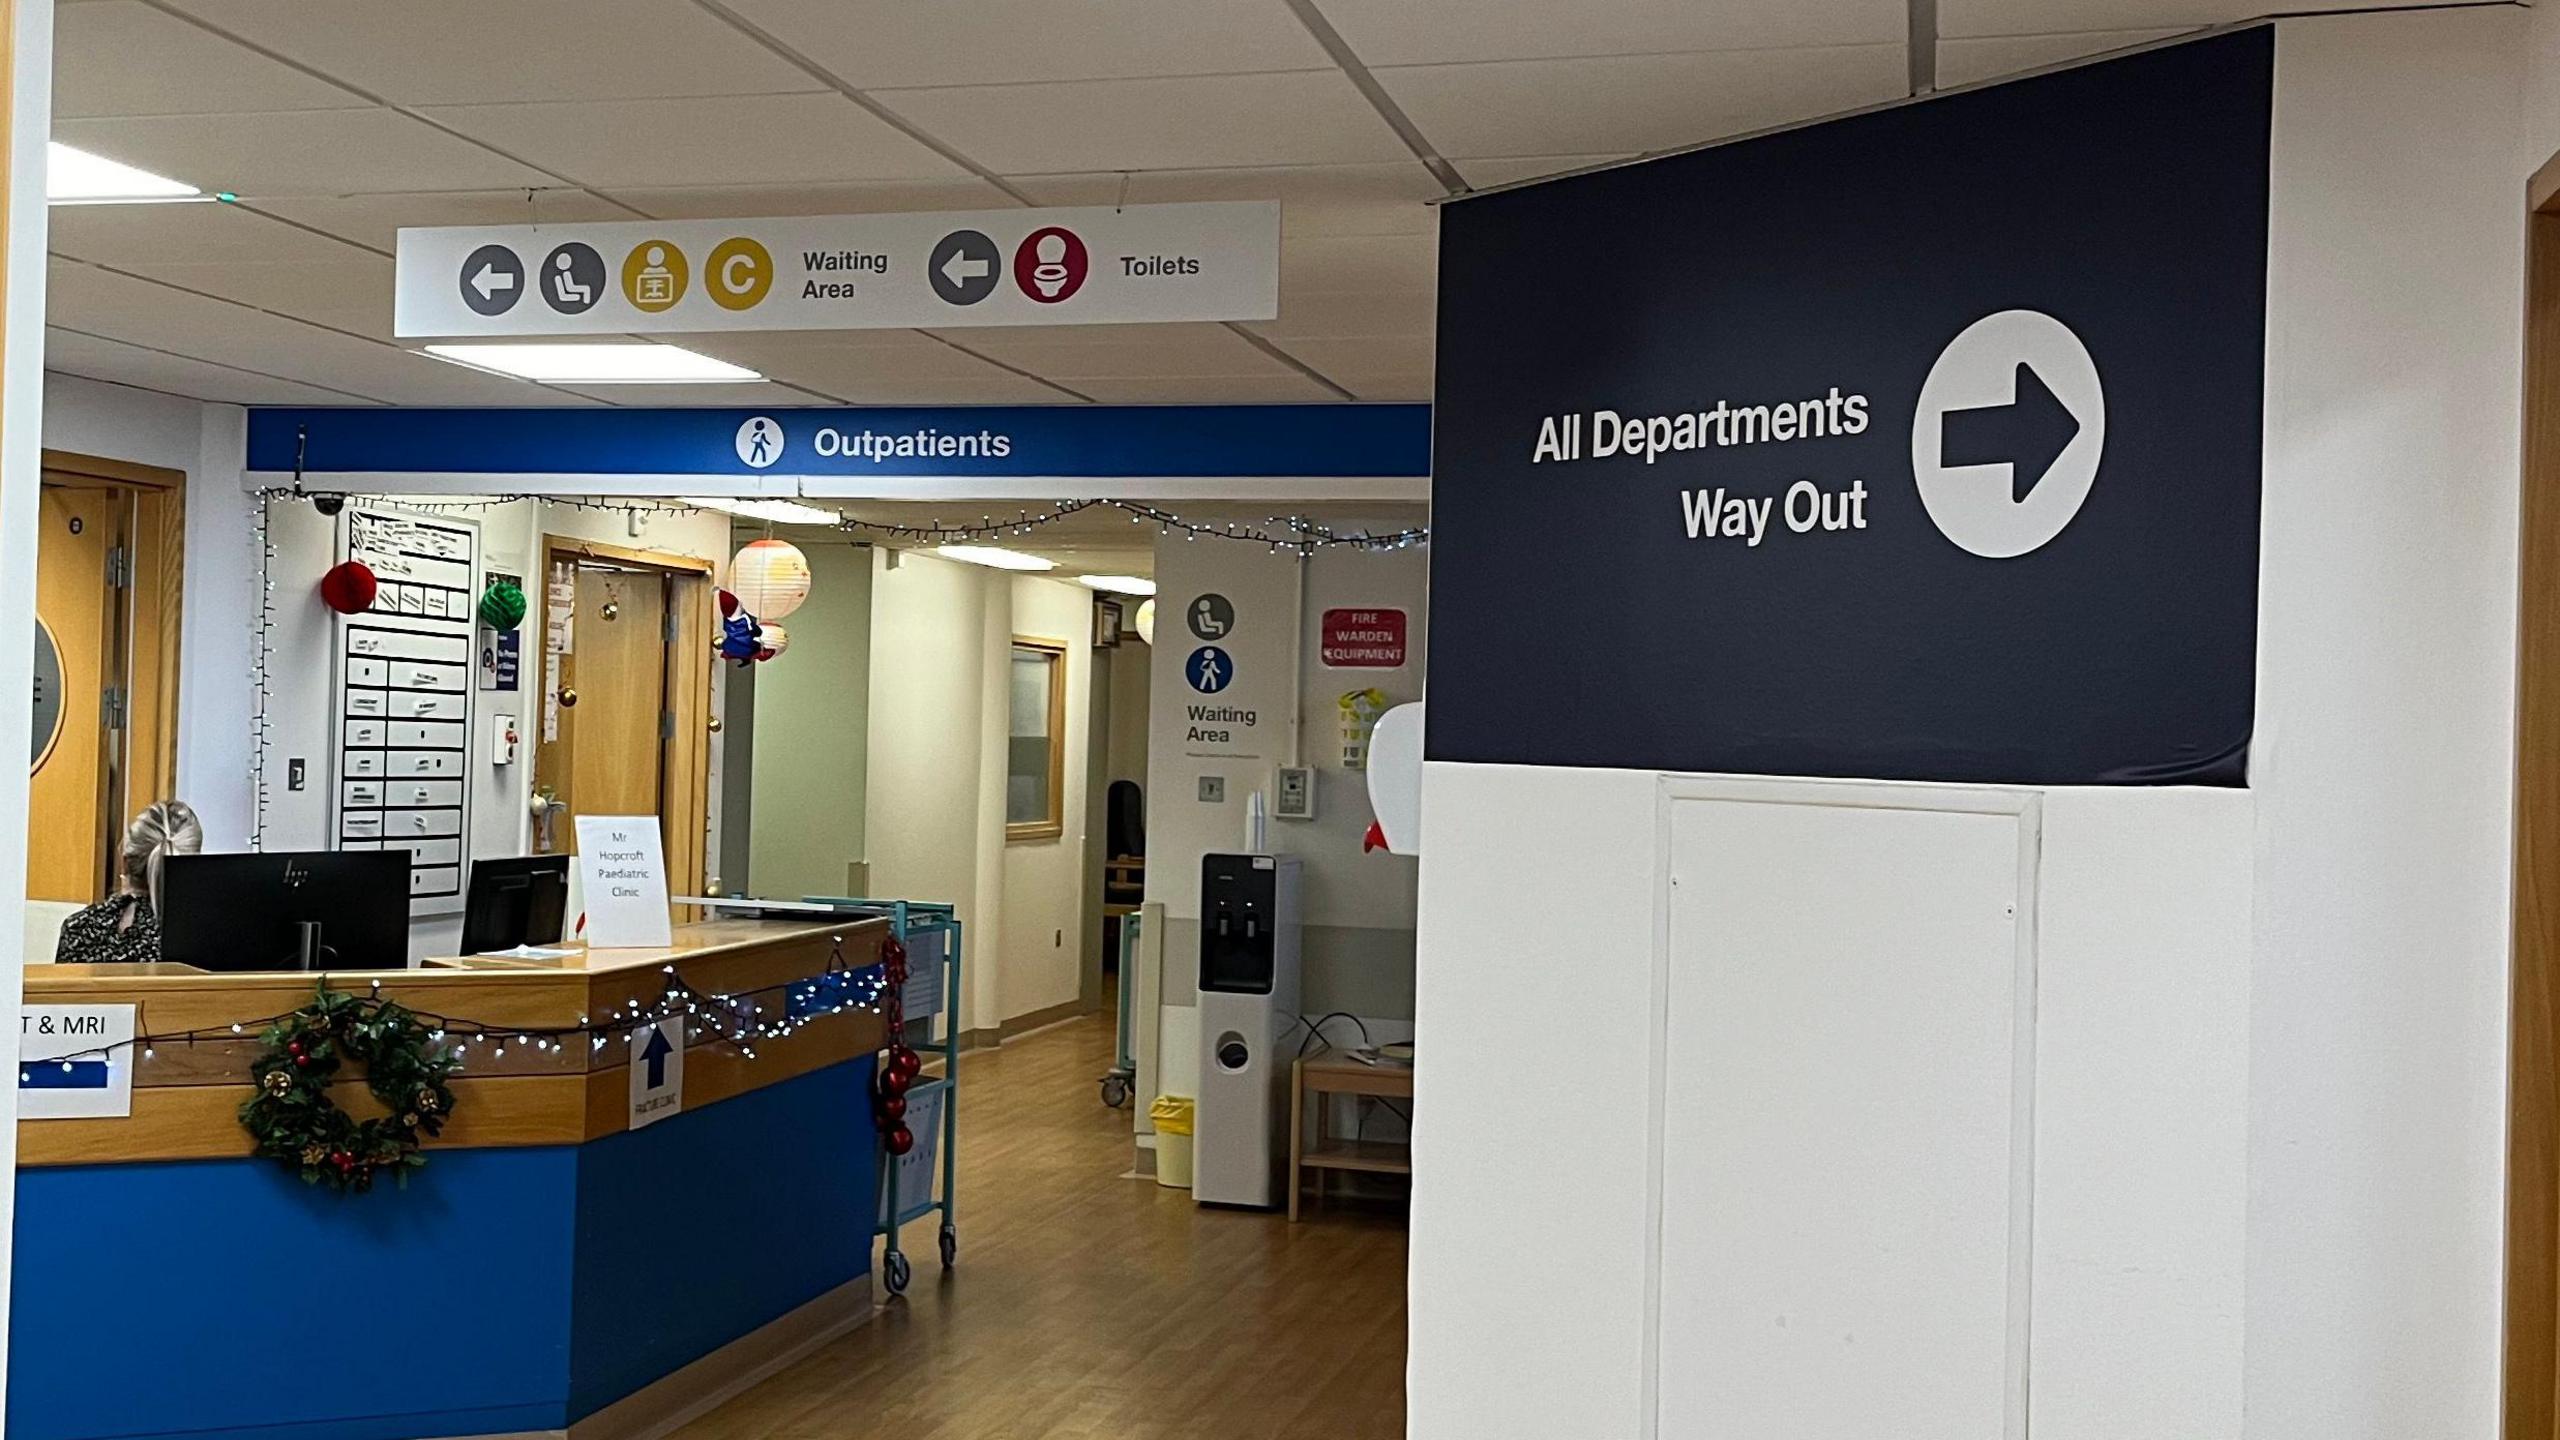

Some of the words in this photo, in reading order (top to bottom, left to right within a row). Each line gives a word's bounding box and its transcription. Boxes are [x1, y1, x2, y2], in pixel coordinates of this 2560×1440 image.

[803, 250, 888, 274] Waiting
[1119, 255, 1200, 277] Toilets
[721, 254, 756, 294] C
[801, 279, 855, 299] Area
[1533, 413, 1581, 463] All
[1592, 387, 1869, 464] Departments
[814, 428, 1010, 463] Outpatients
[1681, 487, 1773, 547] Way
[1784, 479, 1868, 533] Out
[1351, 613, 1378, 624] FIRE
[1336, 631, 1393, 642] WARDEN
[1323, 648, 1402, 660] EQUIPMENT
[1187, 705, 1257, 727] Waiting
[1186, 726, 1230, 742] Area
[612, 832, 627, 842] Mr
[599, 850, 645, 862] Hopcroft
[598, 868, 649, 879] Paediatric
[611, 887, 640, 897] Clinic
[38, 1015, 56, 1034] &
[63, 1016, 105, 1034] MRI
